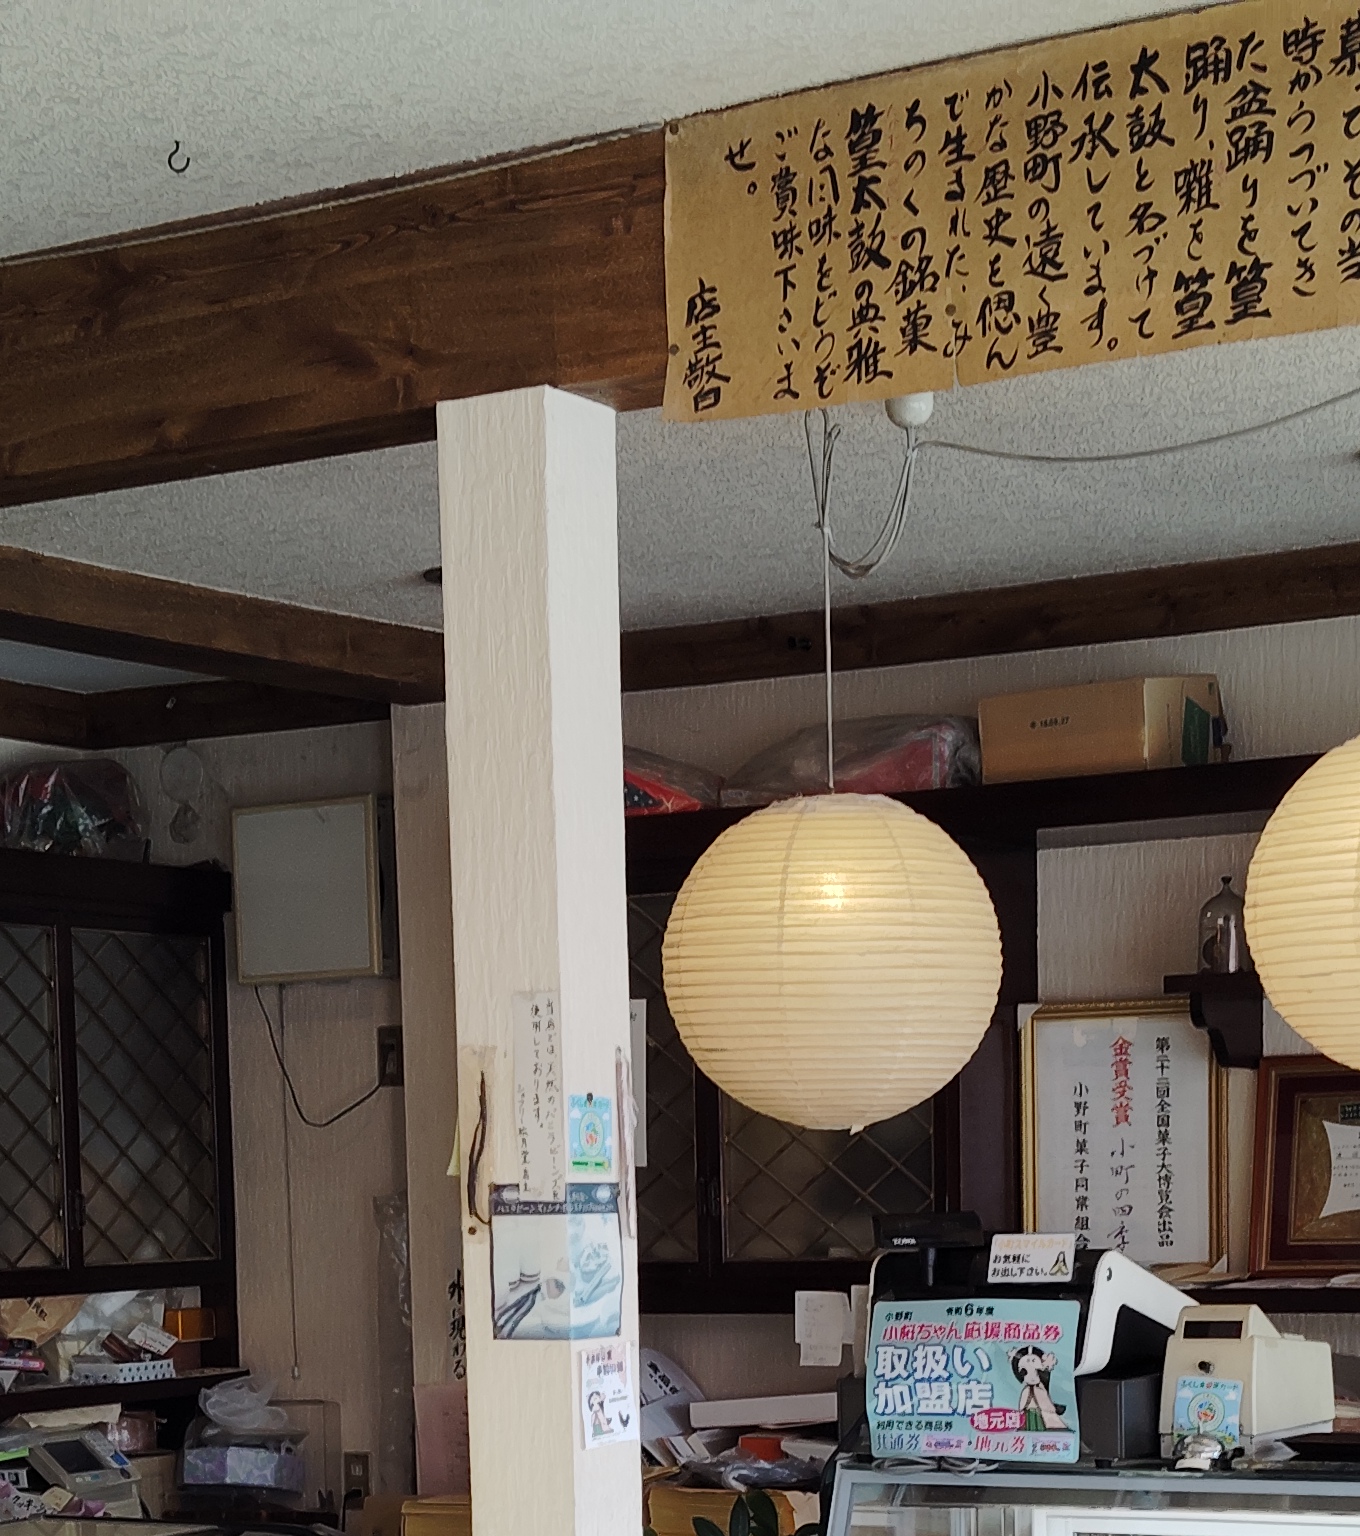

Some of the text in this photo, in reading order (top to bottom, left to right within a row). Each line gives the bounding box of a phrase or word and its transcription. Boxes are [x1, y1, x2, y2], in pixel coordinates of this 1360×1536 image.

[1108, 1035, 1135, 1129] 金賞受賞
[875, 1345, 993, 1381] 取扱い
[874, 1380, 994, 1417] 加盟店
